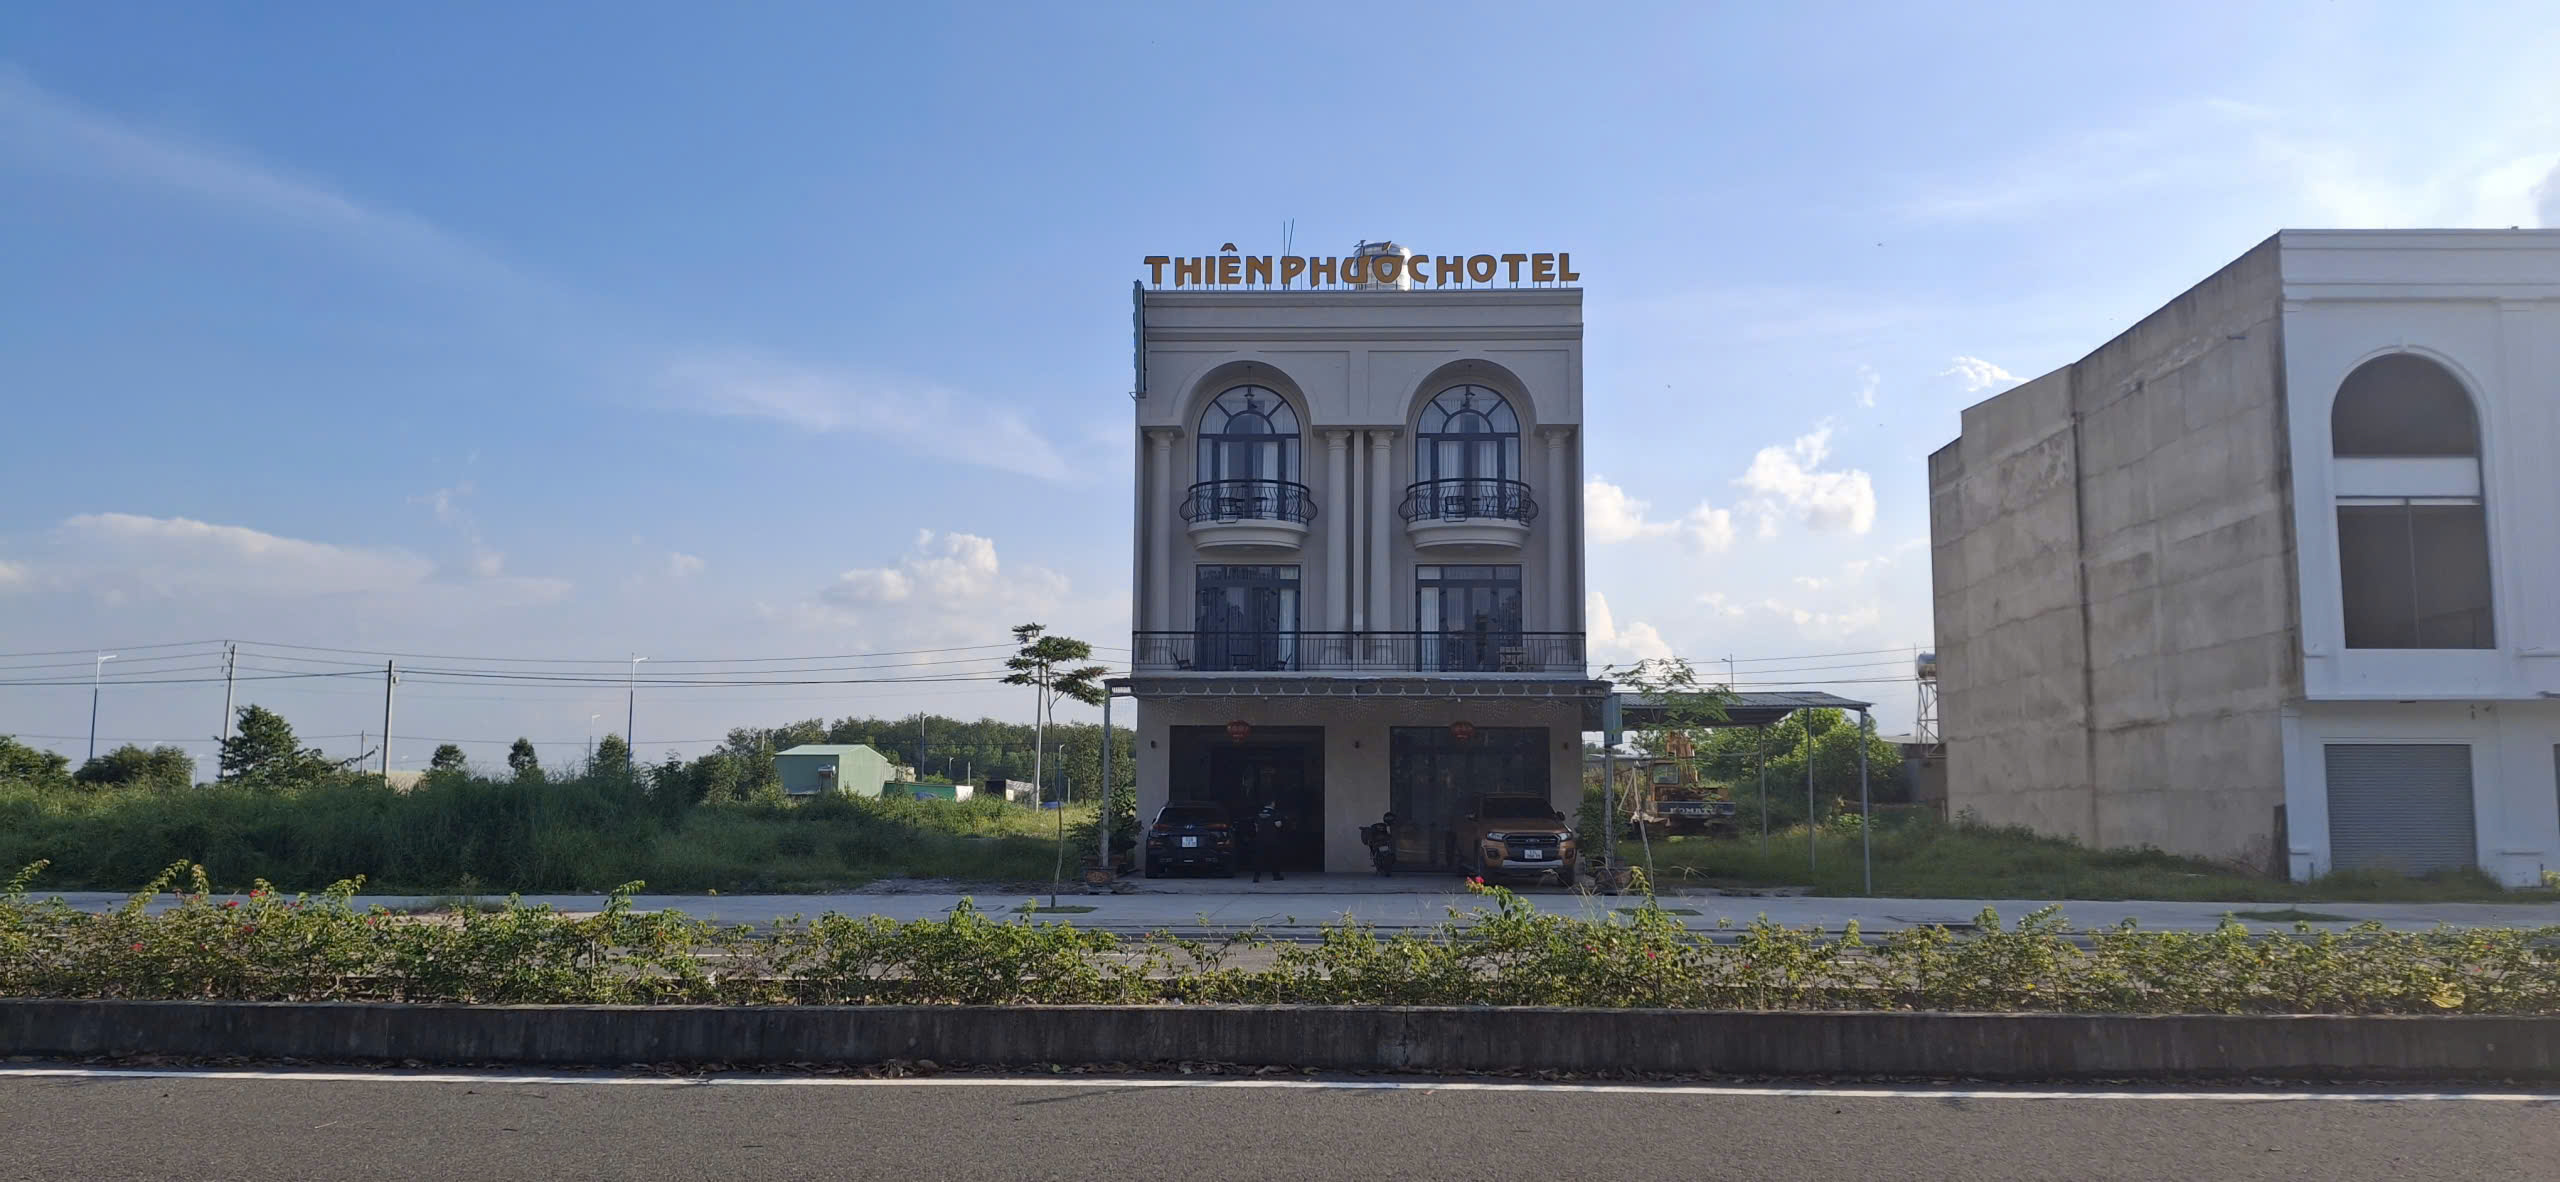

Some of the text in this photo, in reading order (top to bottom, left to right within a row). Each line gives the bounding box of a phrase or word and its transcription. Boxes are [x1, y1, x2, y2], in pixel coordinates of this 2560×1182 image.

[1144, 241, 1581, 288] THIÊN PHƯỚC HOTEL
